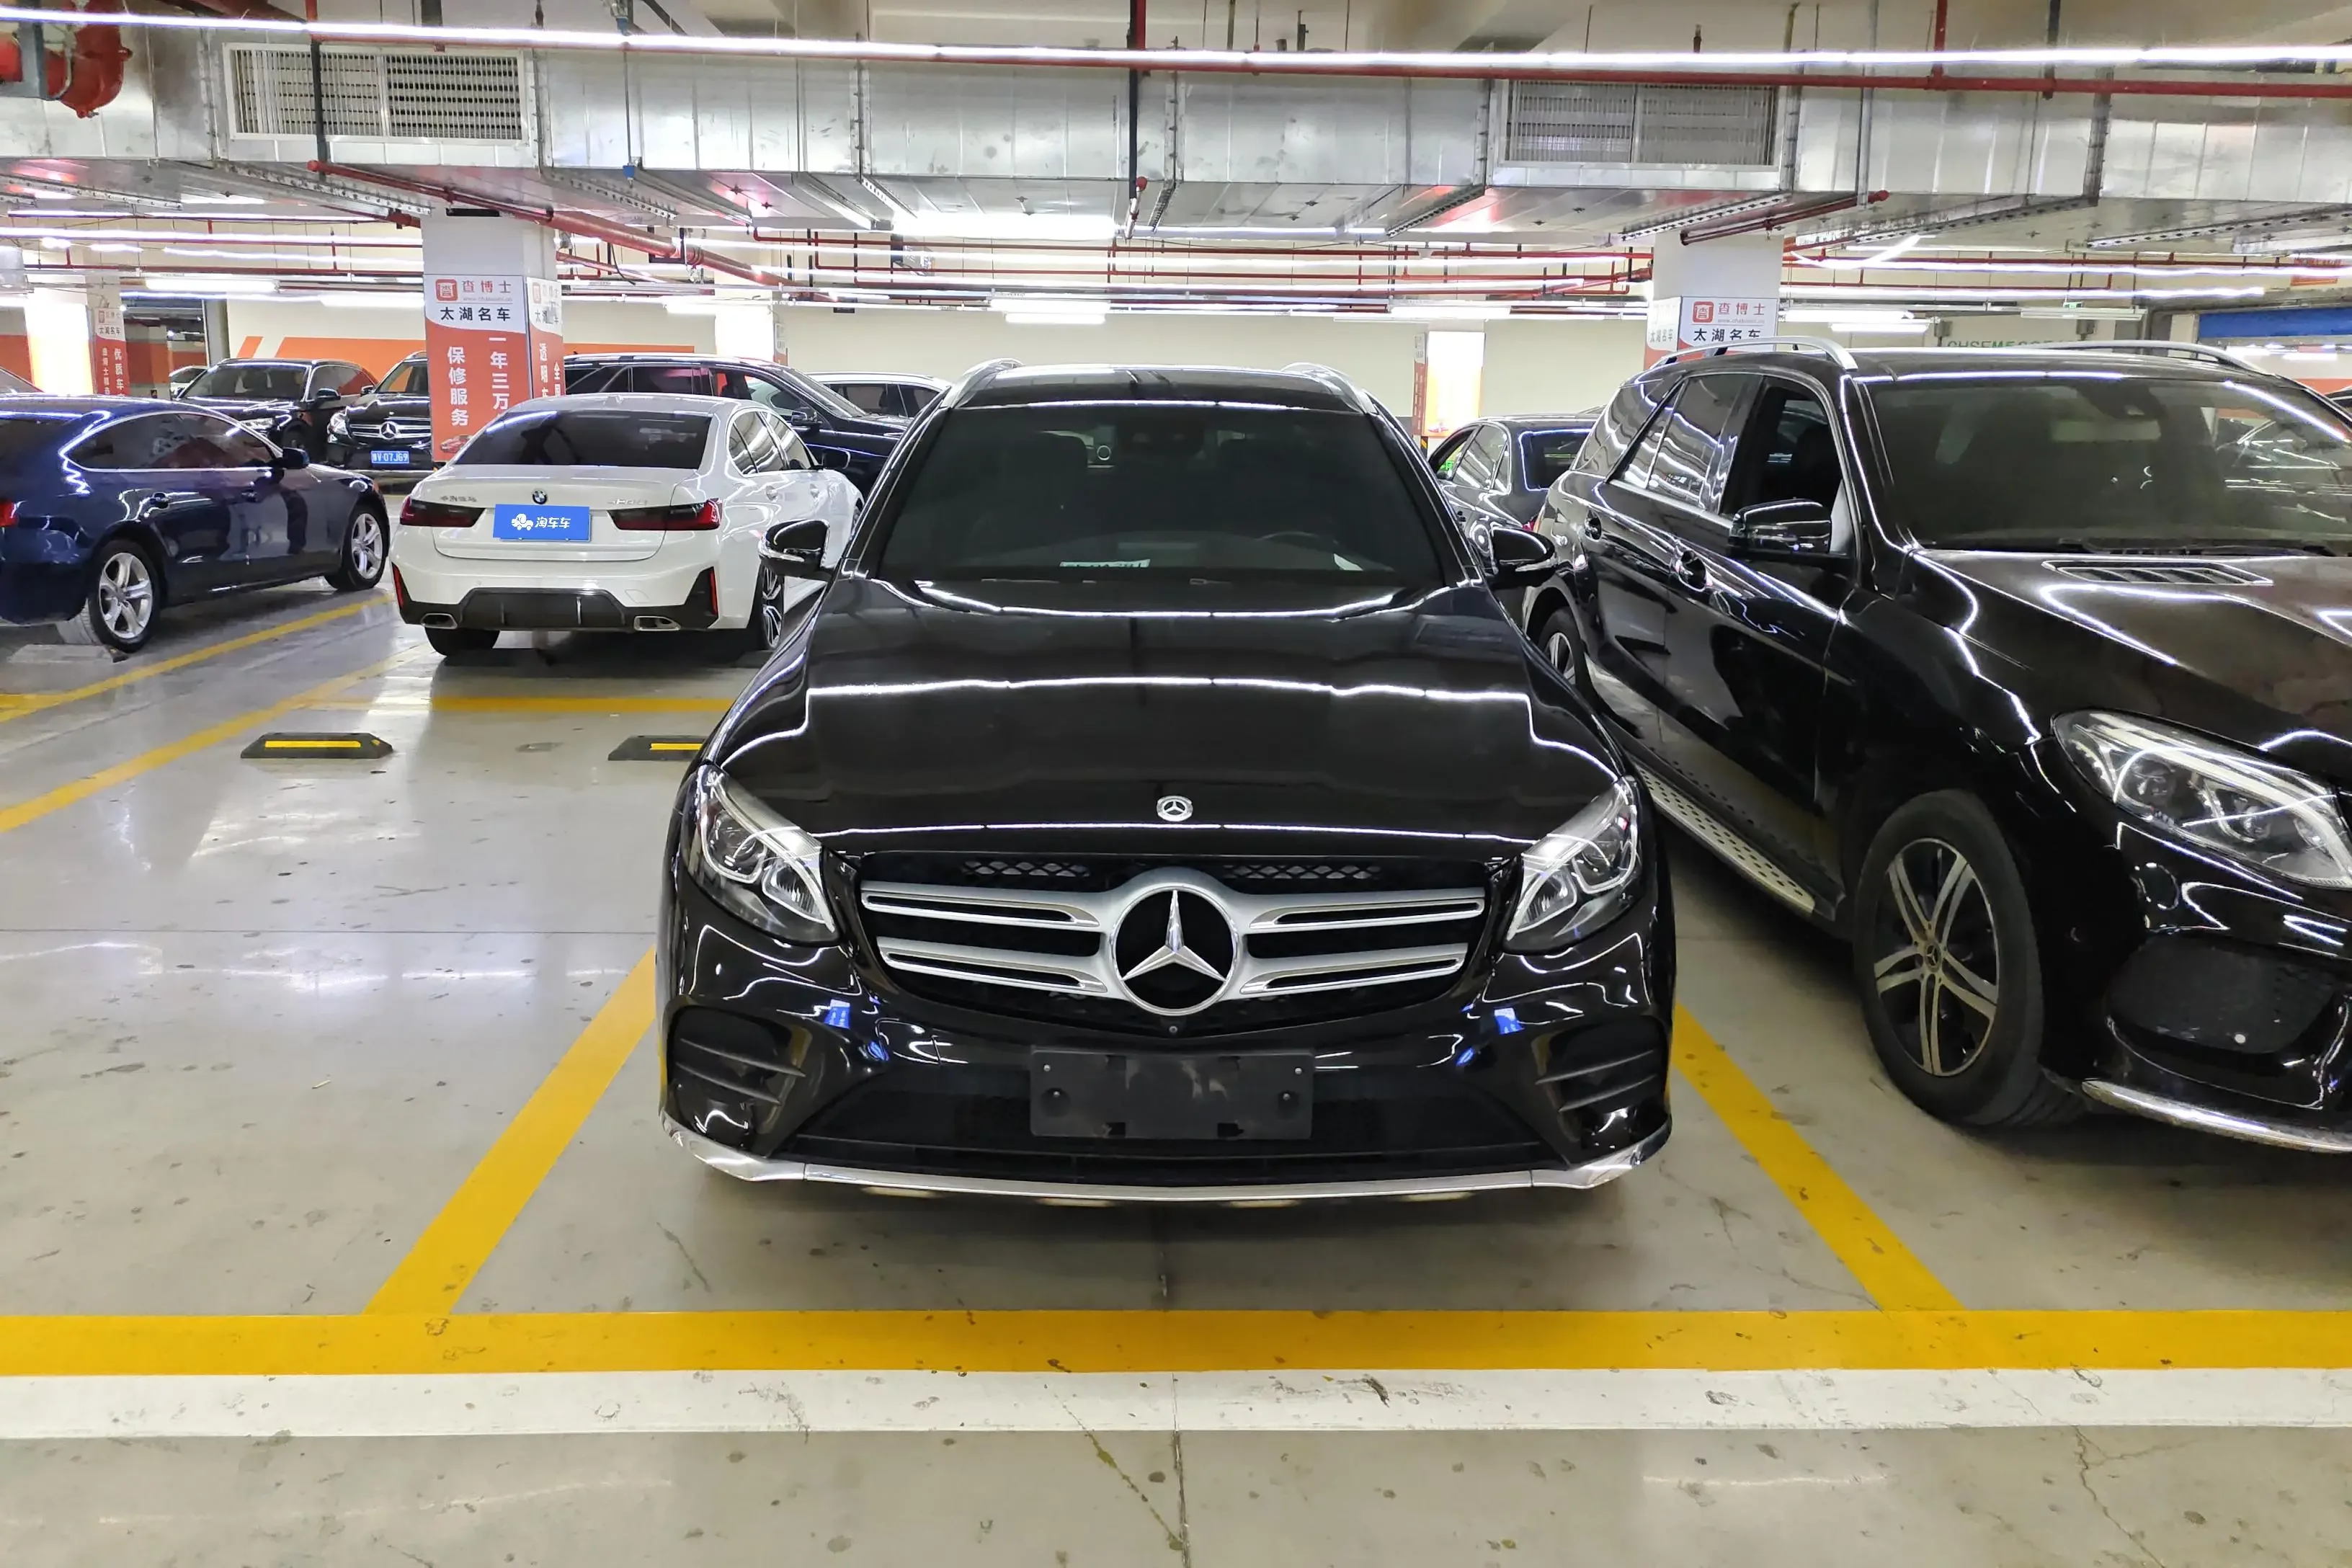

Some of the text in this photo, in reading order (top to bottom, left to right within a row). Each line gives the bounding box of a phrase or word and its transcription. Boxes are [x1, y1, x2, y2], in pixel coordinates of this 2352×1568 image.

[461, 280, 511, 293] 查博士
[440, 307, 511, 321] 太湖名车
[1718, 303, 1765, 316] 查博士
[489, 337, 509, 418] 一年三万
[447, 346, 469, 426] 保修服务
[535, 516, 571, 529] 淘车车
